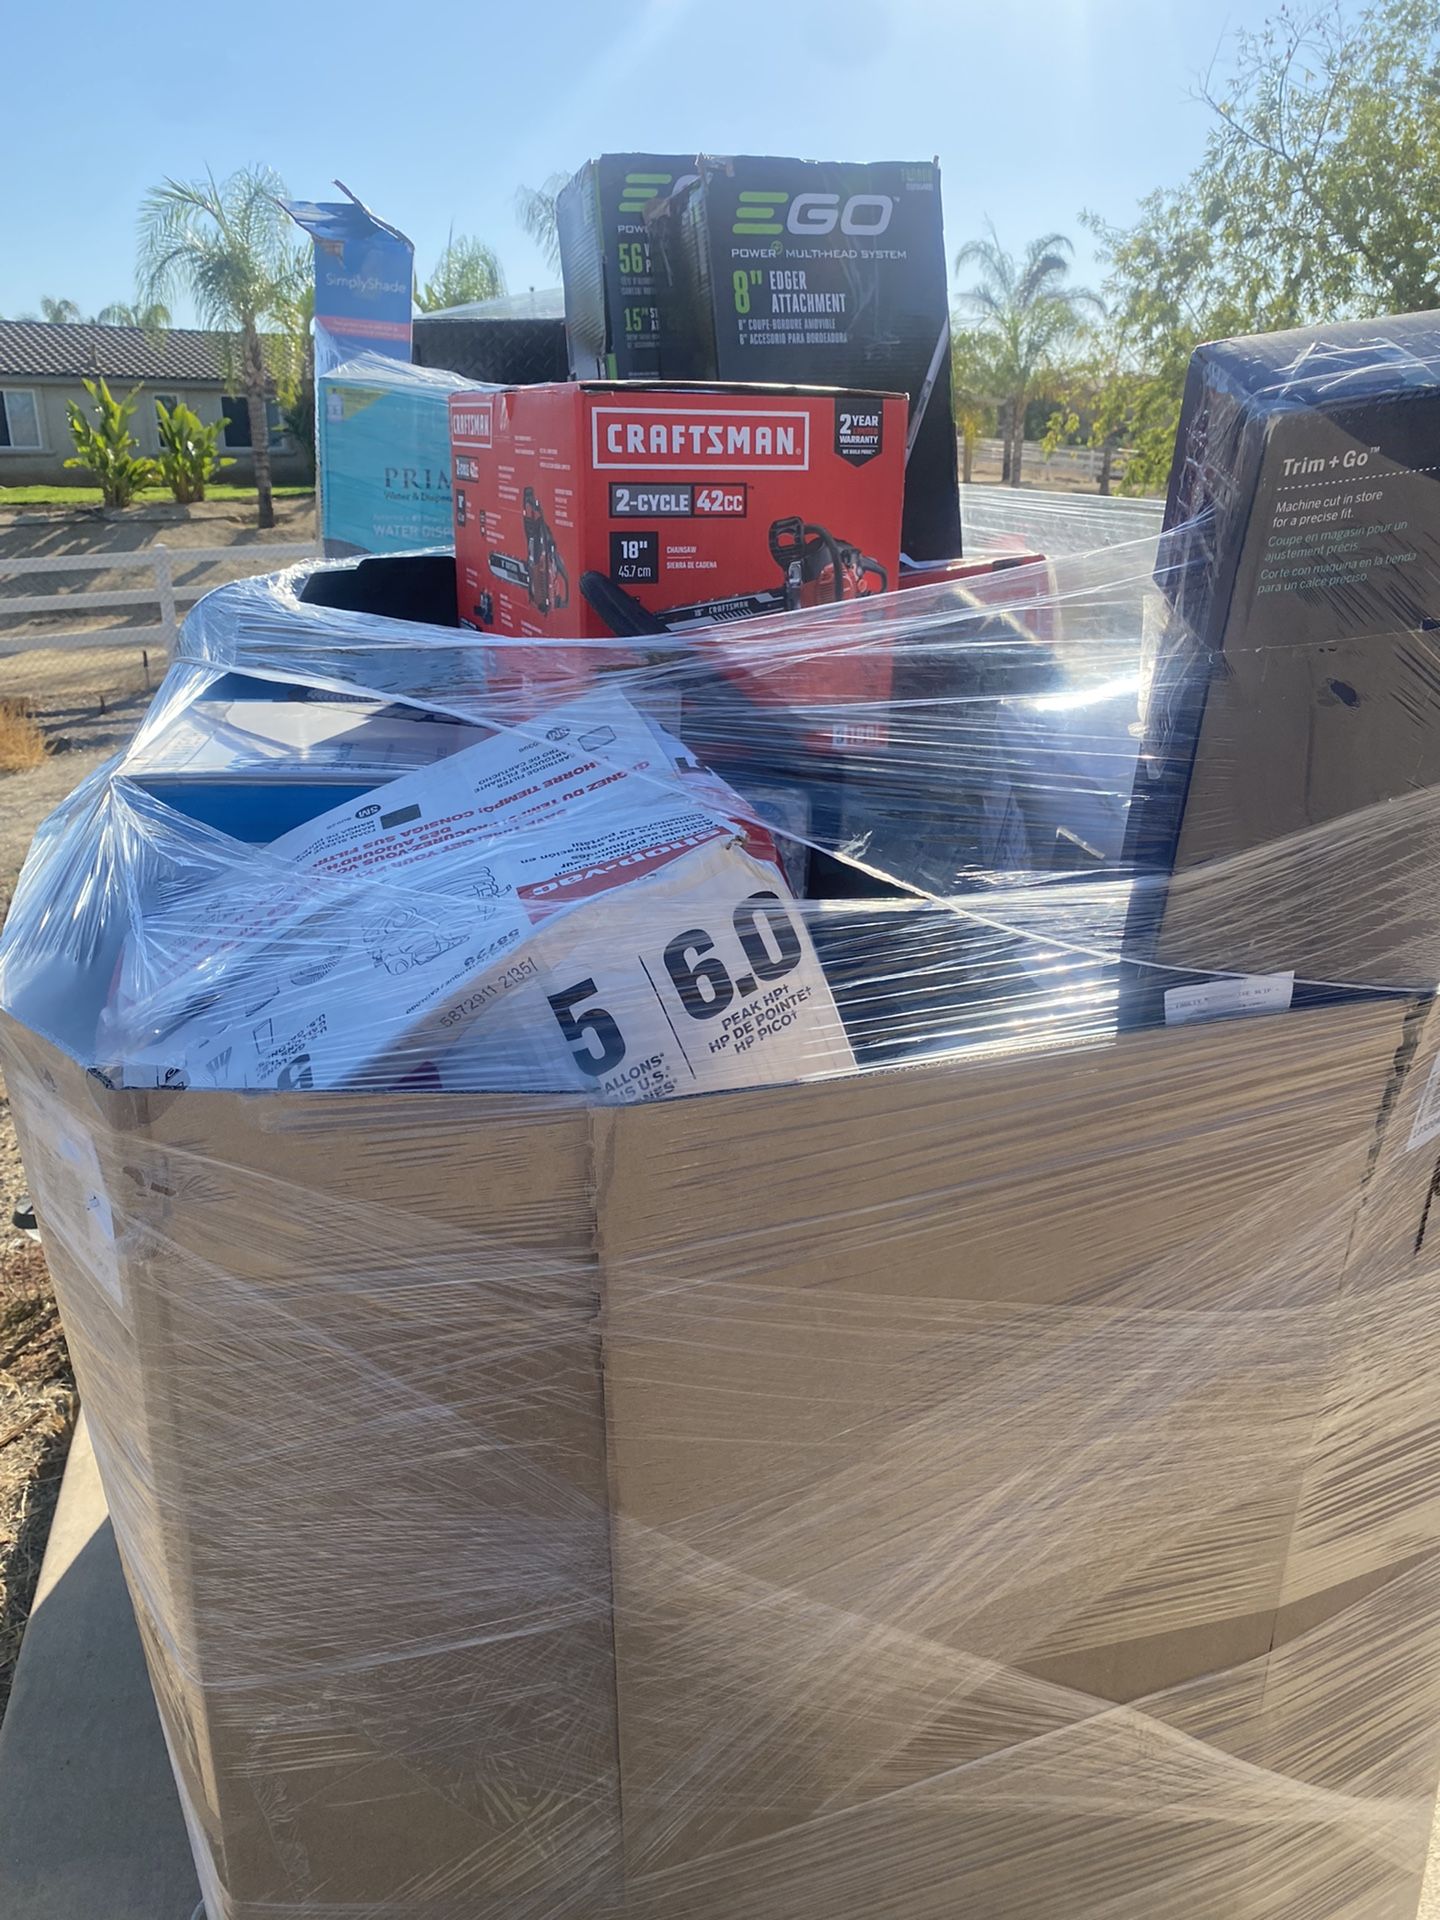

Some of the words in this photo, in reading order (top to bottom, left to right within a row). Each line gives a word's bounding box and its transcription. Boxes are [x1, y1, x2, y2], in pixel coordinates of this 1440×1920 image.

[732, 191, 894, 235] EGO
[617, 225, 650, 233] POW
[618, 243, 643, 273] 56
[731, 248, 777, 259] POWER
[786, 249, 858, 259] MULTI-HEAD
[861, 250, 908, 260] SYSTEM
[326, 271, 407, 294] SimplyShade
[769, 270, 807, 290] EDGER
[771, 293, 846, 313] ATTACHMENT
[749, 333, 786, 344] ACCESORIO
[787, 332, 803, 343] PARA
[452, 413, 490, 436] CRAFTSMAN
[839, 413, 851, 434] 2
[852, 415, 879, 426] YEAR
[606, 423, 796, 456] CRAFTSMAN
[839, 436, 879, 444] WARRANTY
[1282, 456, 1325, 476] Trim
[1328, 455, 1340, 469] +
[384, 467, 452, 490] PRIM
[615, 488, 690, 512] 2-CYCLE
[696, 490, 743, 512] 42CC
[1275, 499, 1322, 514] Machine
[1323, 495, 1341, 507] cut
[1342, 493, 1354, 505] in
[1355, 489, 1384, 503] store
[1272, 516, 1288, 529] for
[1290, 516, 1297, 526] a
[1298, 509, 1339, 527] precise
[1340, 507, 1355, 519] fit.
[372, 524, 419, 537] WATER
[1268, 534, 1302, 548] Coupe
[1304, 532, 1319, 544] en
[1320, 527, 1365, 542] magasin
[1366, 523, 1393, 536] pour
[1393, 520, 1408, 531] un
[621, 540, 648, 559] 18"
[666, 546, 697, 554] CHAINSAW
[1264, 545, 1325, 564] ajustement
[618, 565, 636, 578] 45.7
[637, 566, 651, 578] cm
[1260, 567, 1290, 580] Corte
[1291, 565, 1312, 576] con
[1359, 555, 1373, 567] en
[1373, 553, 1384, 565] la
[1385, 551, 1417, 564] tienda
[1256, 580, 1282, 596] para
[1284, 580, 1298, 591] un
[1300, 576, 1327, 589] calce
[708, 601, 749, 615] CRAFTSMAN
[519, 750, 566, 773] ARTOUCHE
[542, 760, 598, 788] HORRE
[561, 787, 584, 801] DU
[400, 810, 473, 837] CONSIGA
[362, 834, 396, 850] SUS
[325, 838, 413, 872] AUJOURD'H
[440, 985, 497, 1028] 5872911
[498, 956, 539, 989] 21351
[547, 977, 626, 1077] 5
[663, 890, 802, 1020] 6.0
[721, 999, 760, 1031] PEAK
[709, 1034, 732, 1053] HP
[732, 1021, 755, 1041] DE
[734, 1035, 756, 1054] HP
[604, 1052, 664, 1095] ALLONS
